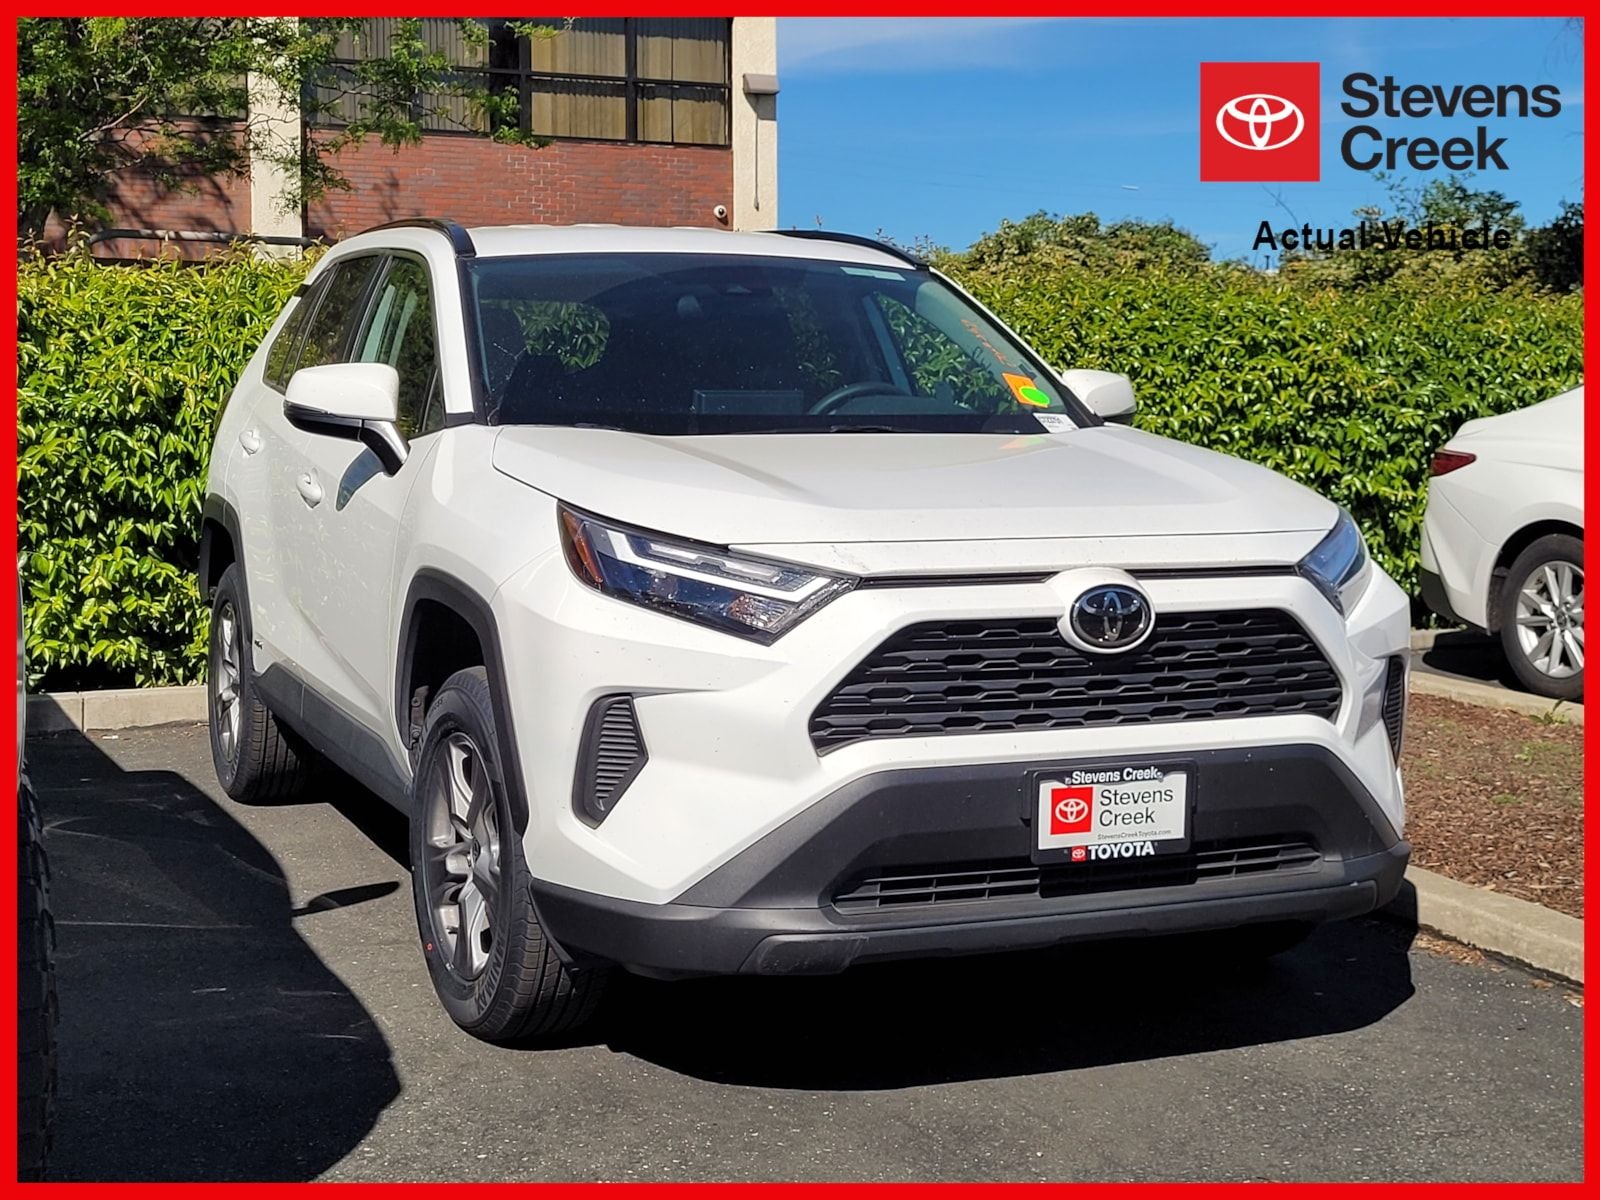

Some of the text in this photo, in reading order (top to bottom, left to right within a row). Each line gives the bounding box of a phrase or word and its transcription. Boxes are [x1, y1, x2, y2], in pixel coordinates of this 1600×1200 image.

[1072, 766, 1159, 785] Stevens Creek
[1100, 788, 1174, 807] Stevens
[1099, 807, 1156, 827] Creek
[1088, 841, 1156, 861] TOYOTA
